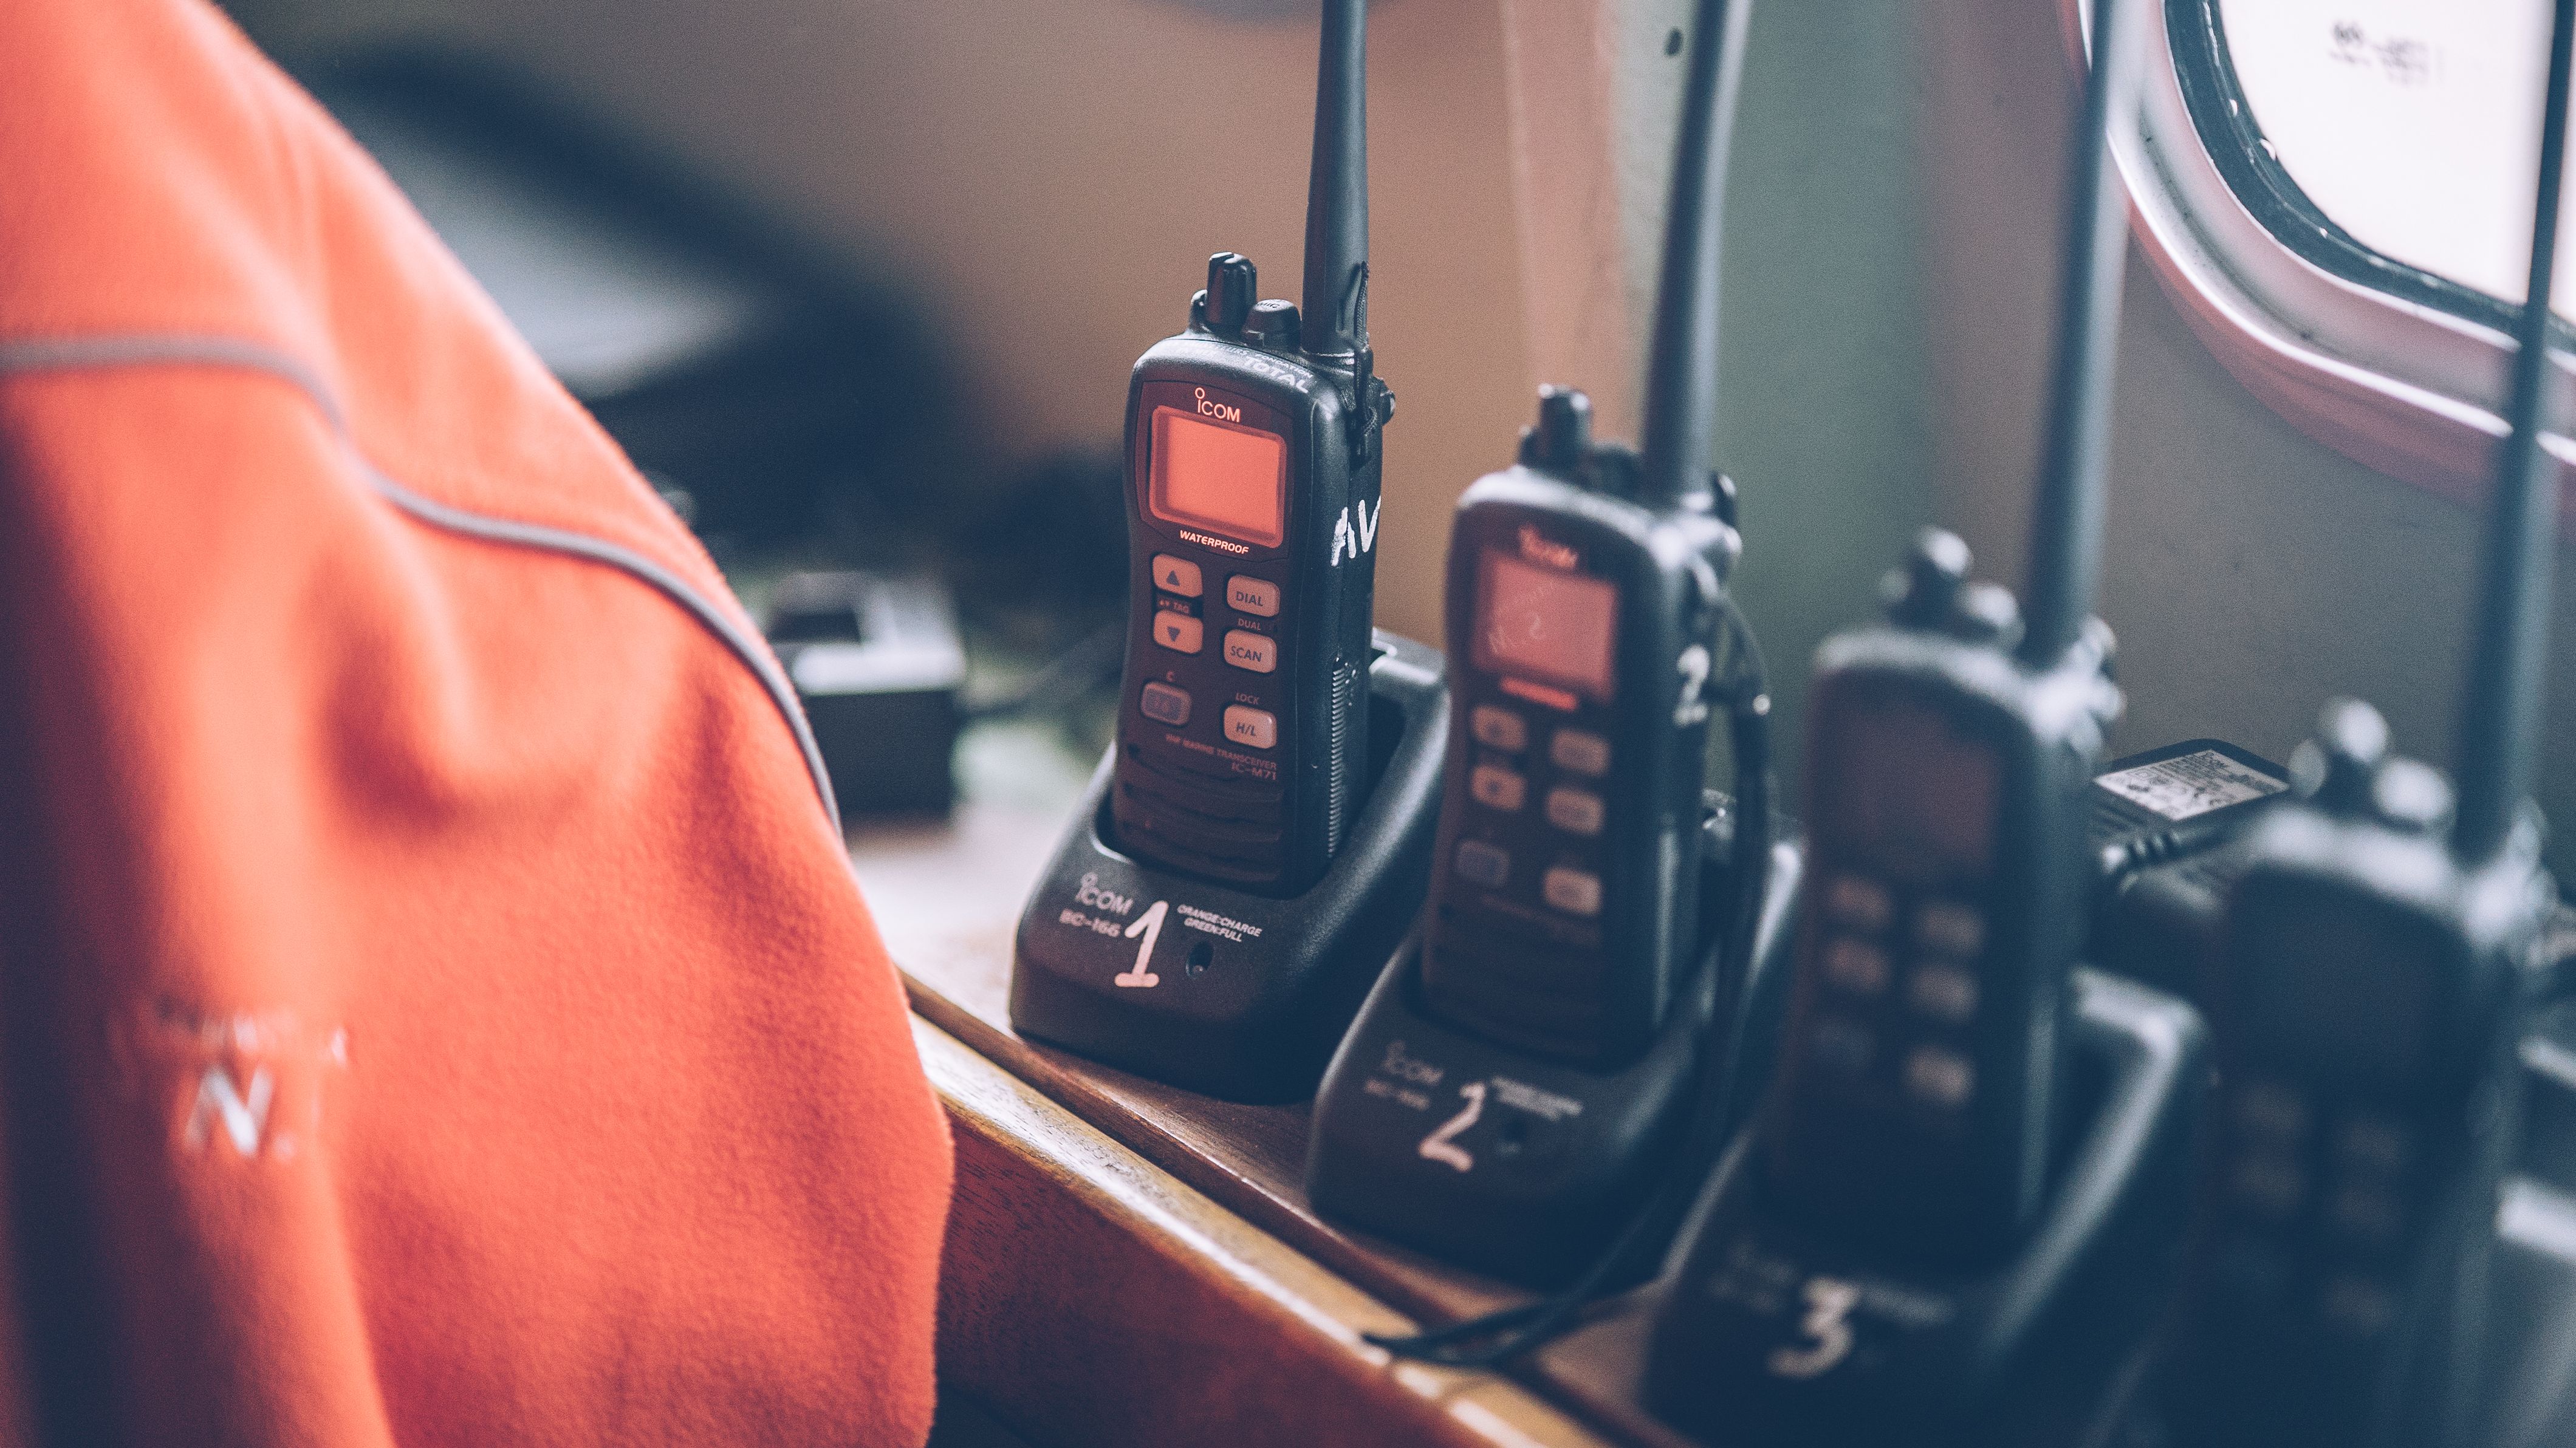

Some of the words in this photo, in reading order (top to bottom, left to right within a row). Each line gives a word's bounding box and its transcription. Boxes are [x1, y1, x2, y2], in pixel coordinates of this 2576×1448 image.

[1244, 355, 1309, 394] TOTAL
[1179, 530, 1249, 555] WATERPROOF
[1235, 590, 1264, 607] DIAL
[1238, 618, 1262, 631] DUAL
[1230, 645, 1262, 663] SCAN
[1235, 692, 1259, 706] LOCK
[1235, 721, 1257, 737] H/L
[1217, 748, 1276, 770] TRANSCEIVER
[1059, 908, 1122, 938] BC-166
[1114, 900, 1170, 988] 1
[1418, 1081, 1486, 1173] 2
[1766, 1276, 1859, 1380] 3
